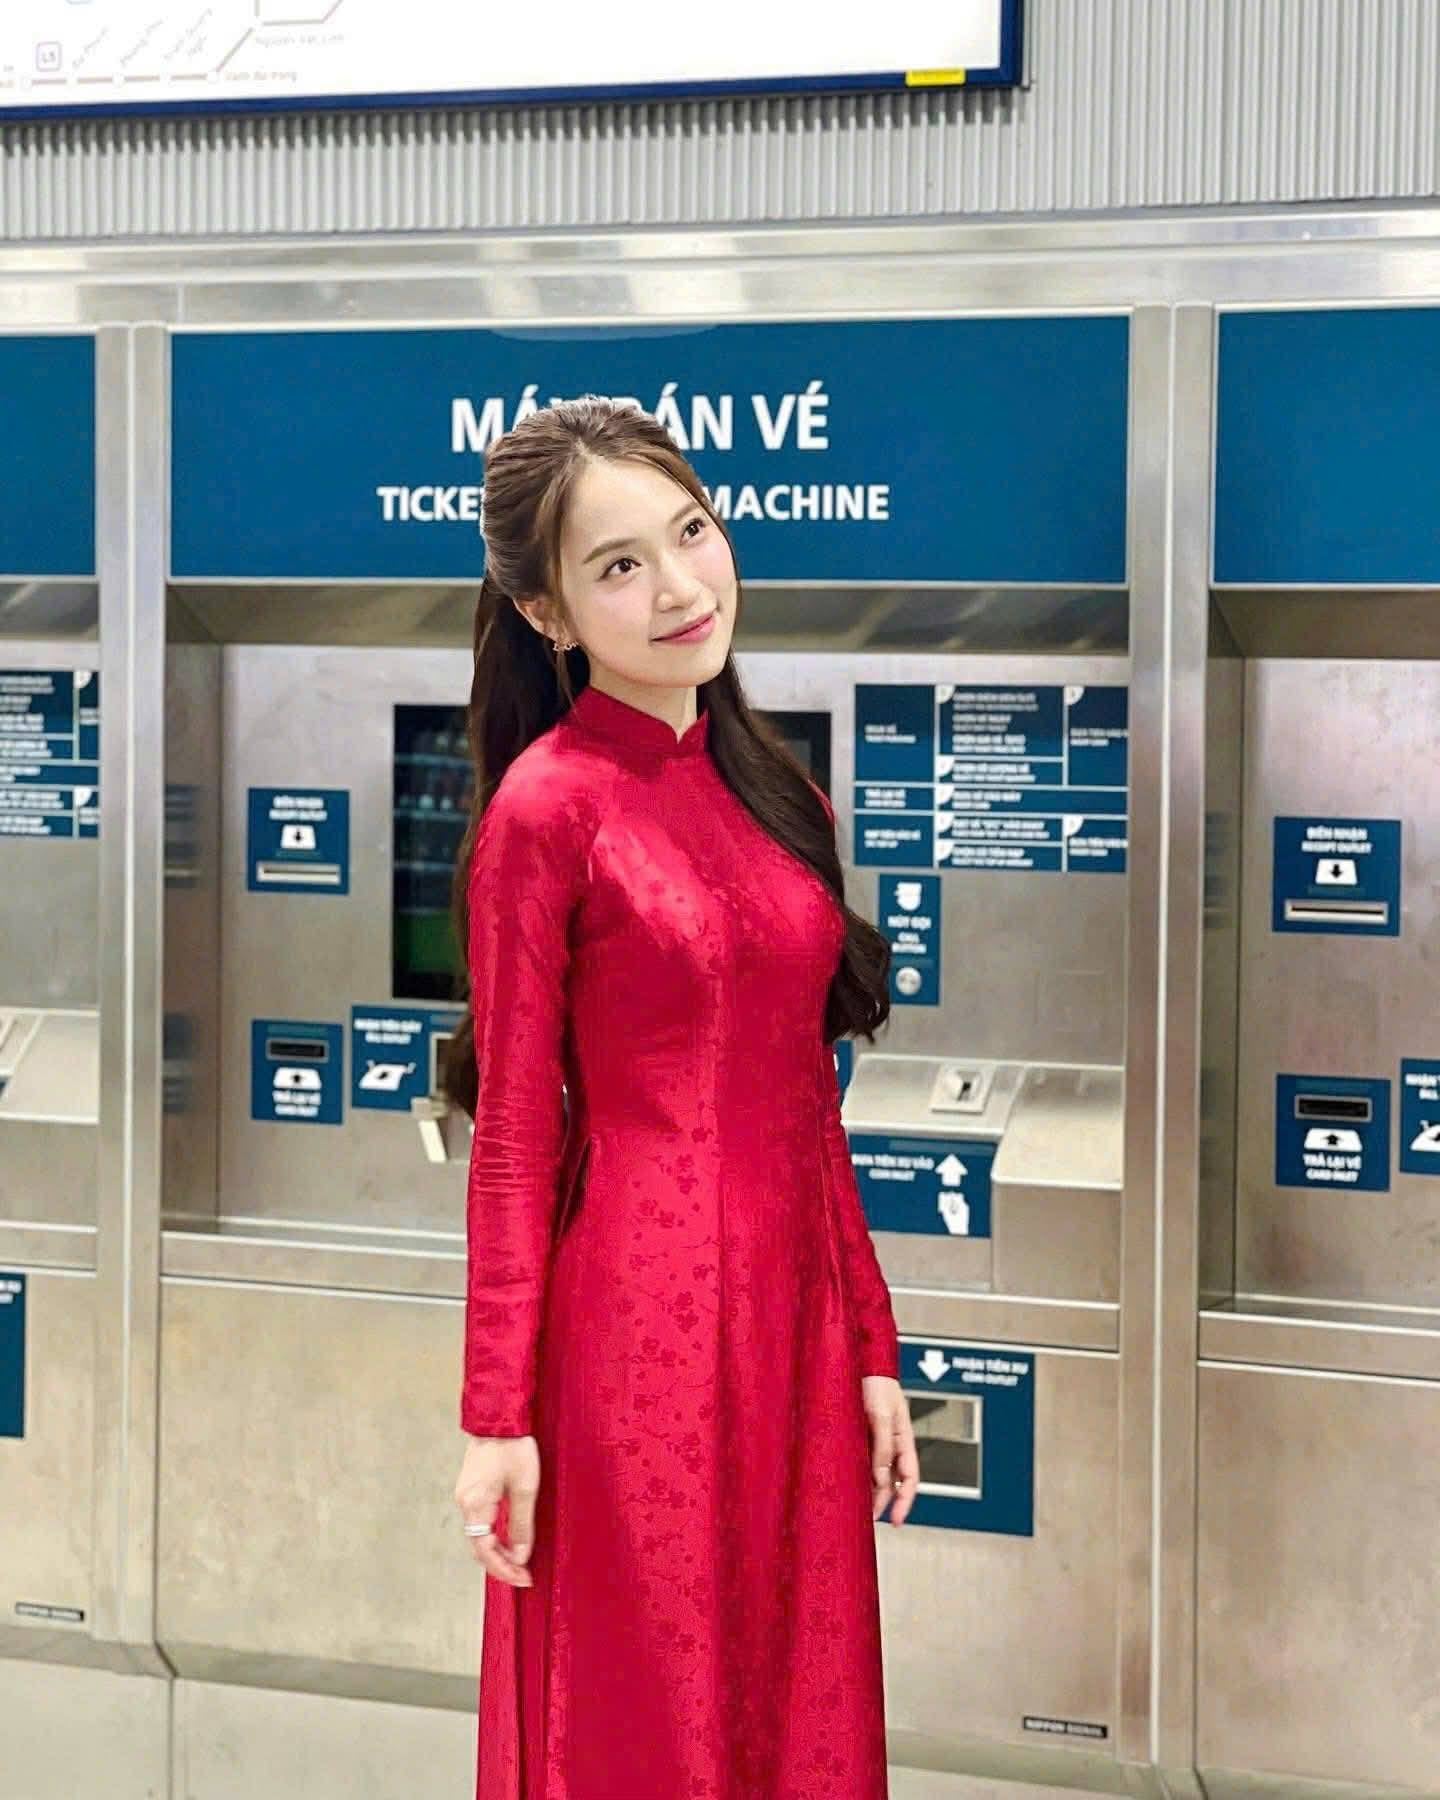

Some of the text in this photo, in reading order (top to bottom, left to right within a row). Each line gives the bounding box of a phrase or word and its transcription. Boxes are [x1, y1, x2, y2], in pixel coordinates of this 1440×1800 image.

[452, 380, 829, 452] MÁ ÁN VÉ
[376, 485, 890, 521] TICKE MACHINE
